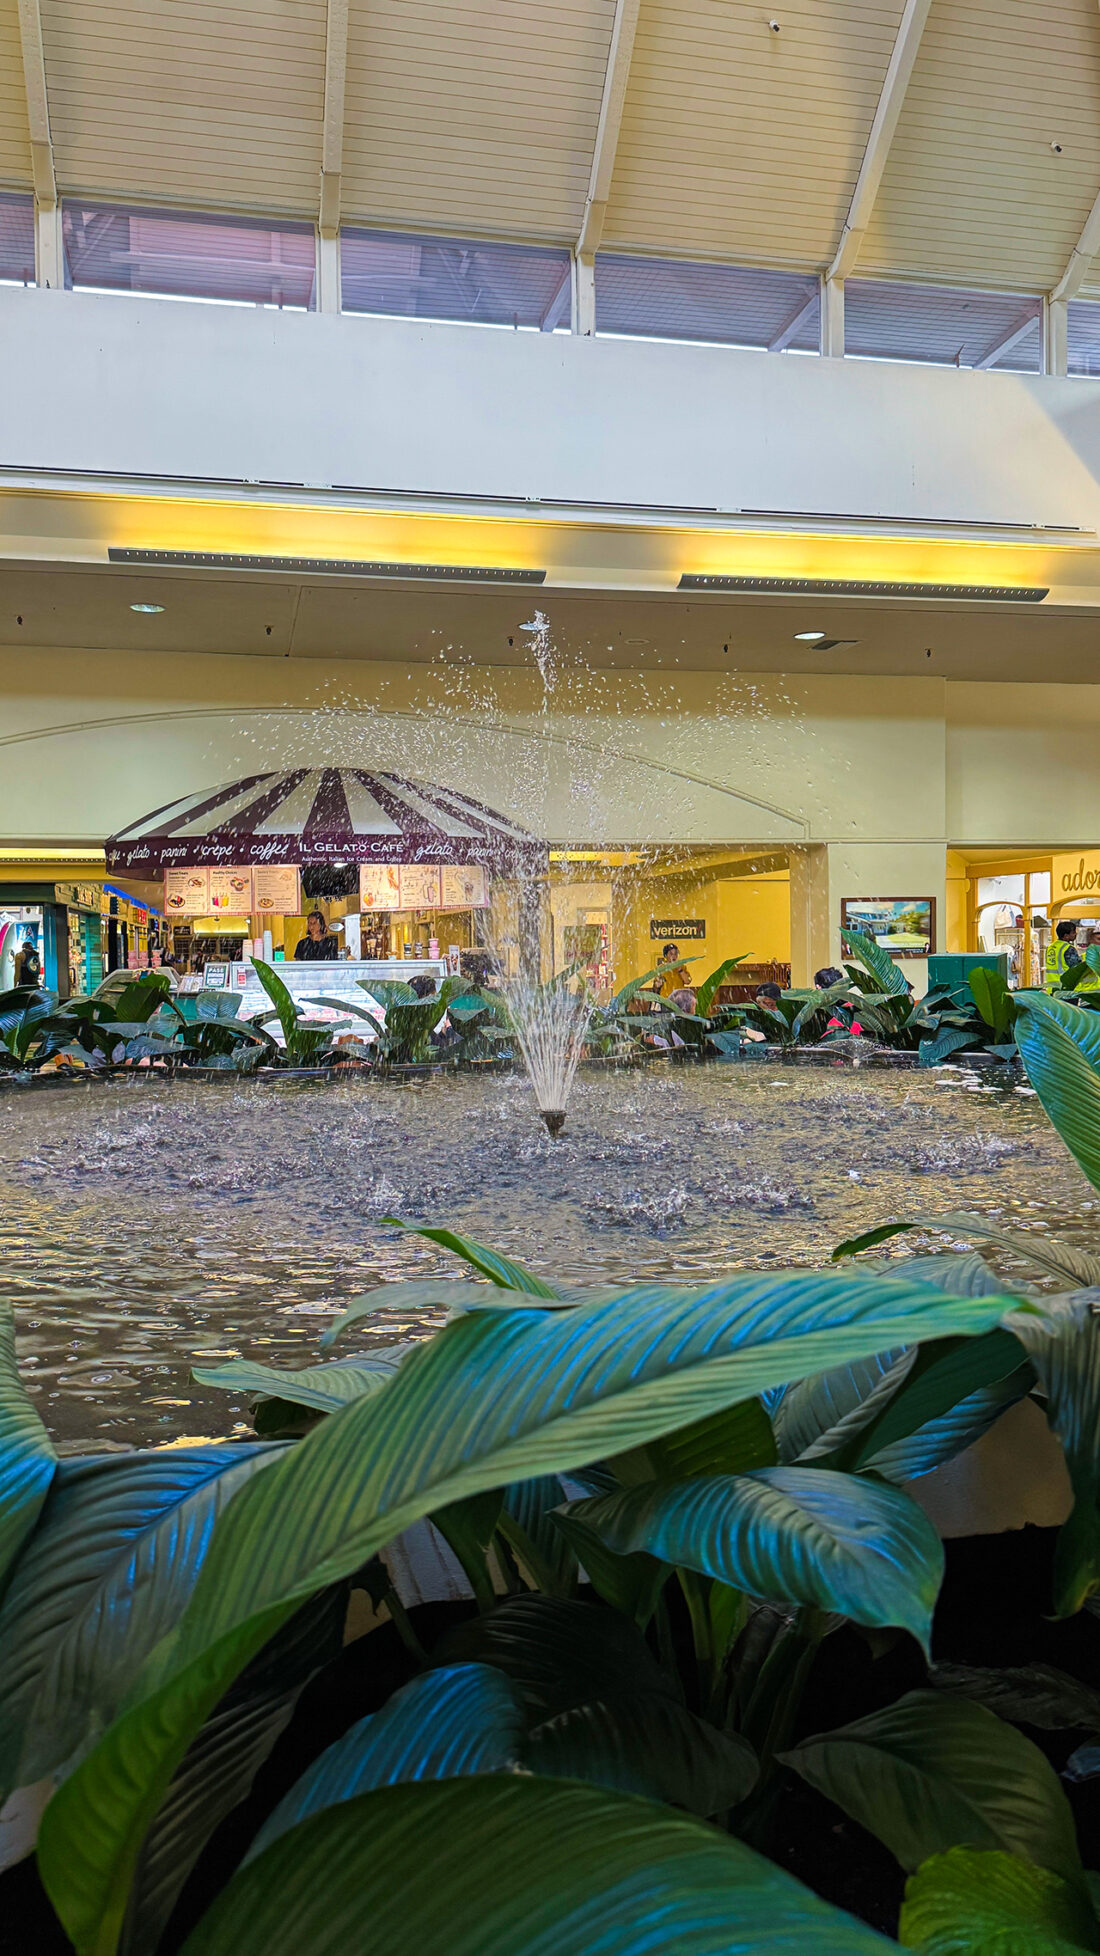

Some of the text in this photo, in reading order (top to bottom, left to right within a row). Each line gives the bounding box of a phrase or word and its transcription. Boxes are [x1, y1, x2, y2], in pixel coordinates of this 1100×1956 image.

[126, 844, 151, 866] gelato
[159, 843, 189, 864] panini
[250, 842, 289, 860] coffee
[314, 842, 367, 852] GELATO
[370, 841, 404, 852] CAFÉ
[414, 842, 453, 861] gelato
[653, 924, 697, 936] verizon
